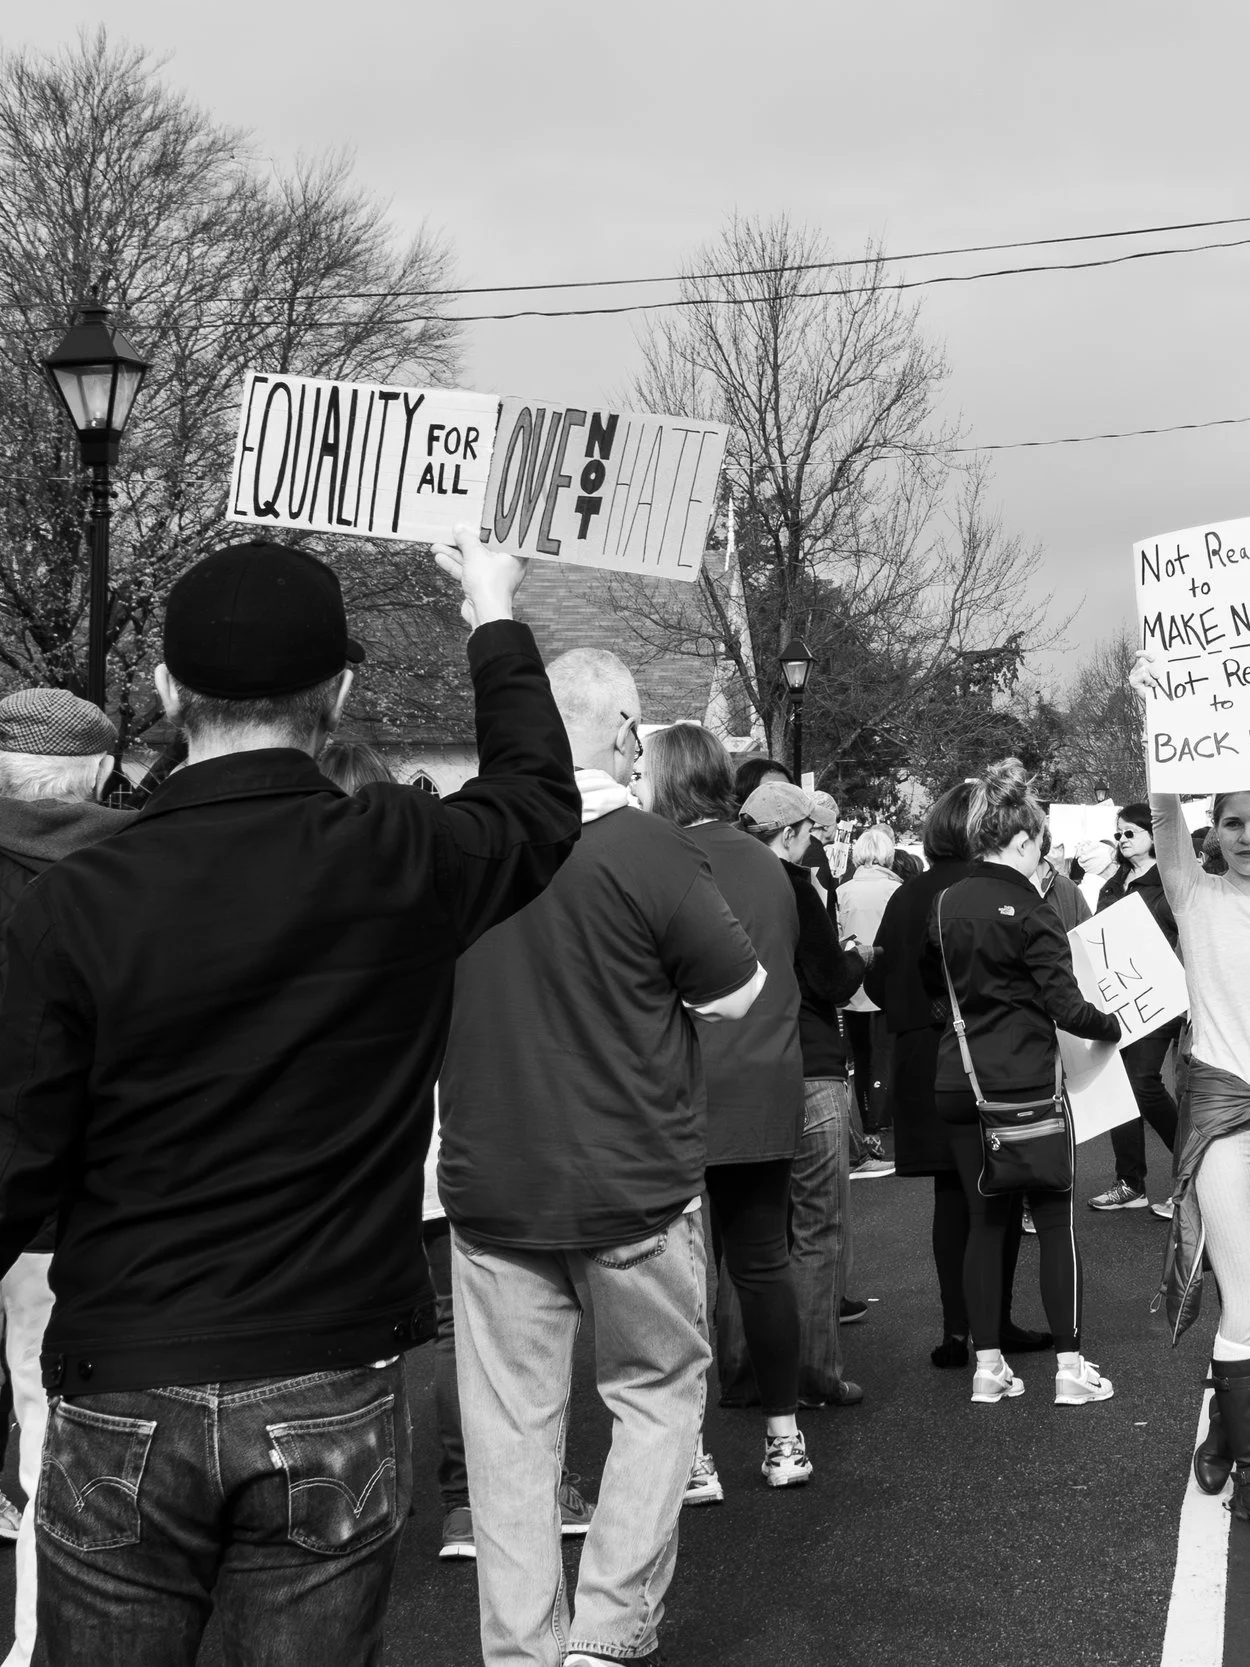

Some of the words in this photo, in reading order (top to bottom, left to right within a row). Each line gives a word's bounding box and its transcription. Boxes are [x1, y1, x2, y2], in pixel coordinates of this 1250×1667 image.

[234, 375, 426, 532] EQUALITY
[427, 424, 480, 460] FOR
[417, 463, 468, 495] ALL
[575, 412, 618, 540] NOT
[602, 421, 719, 567] HATE
[1140, 543, 1190, 586] Not
[1188, 577, 1211, 598] to
[1143, 607, 1226, 651] MAKE
[1151, 670, 1209, 701] Not
[1210, 694, 1234, 712] to
[1154, 731, 1240, 763] BACK
